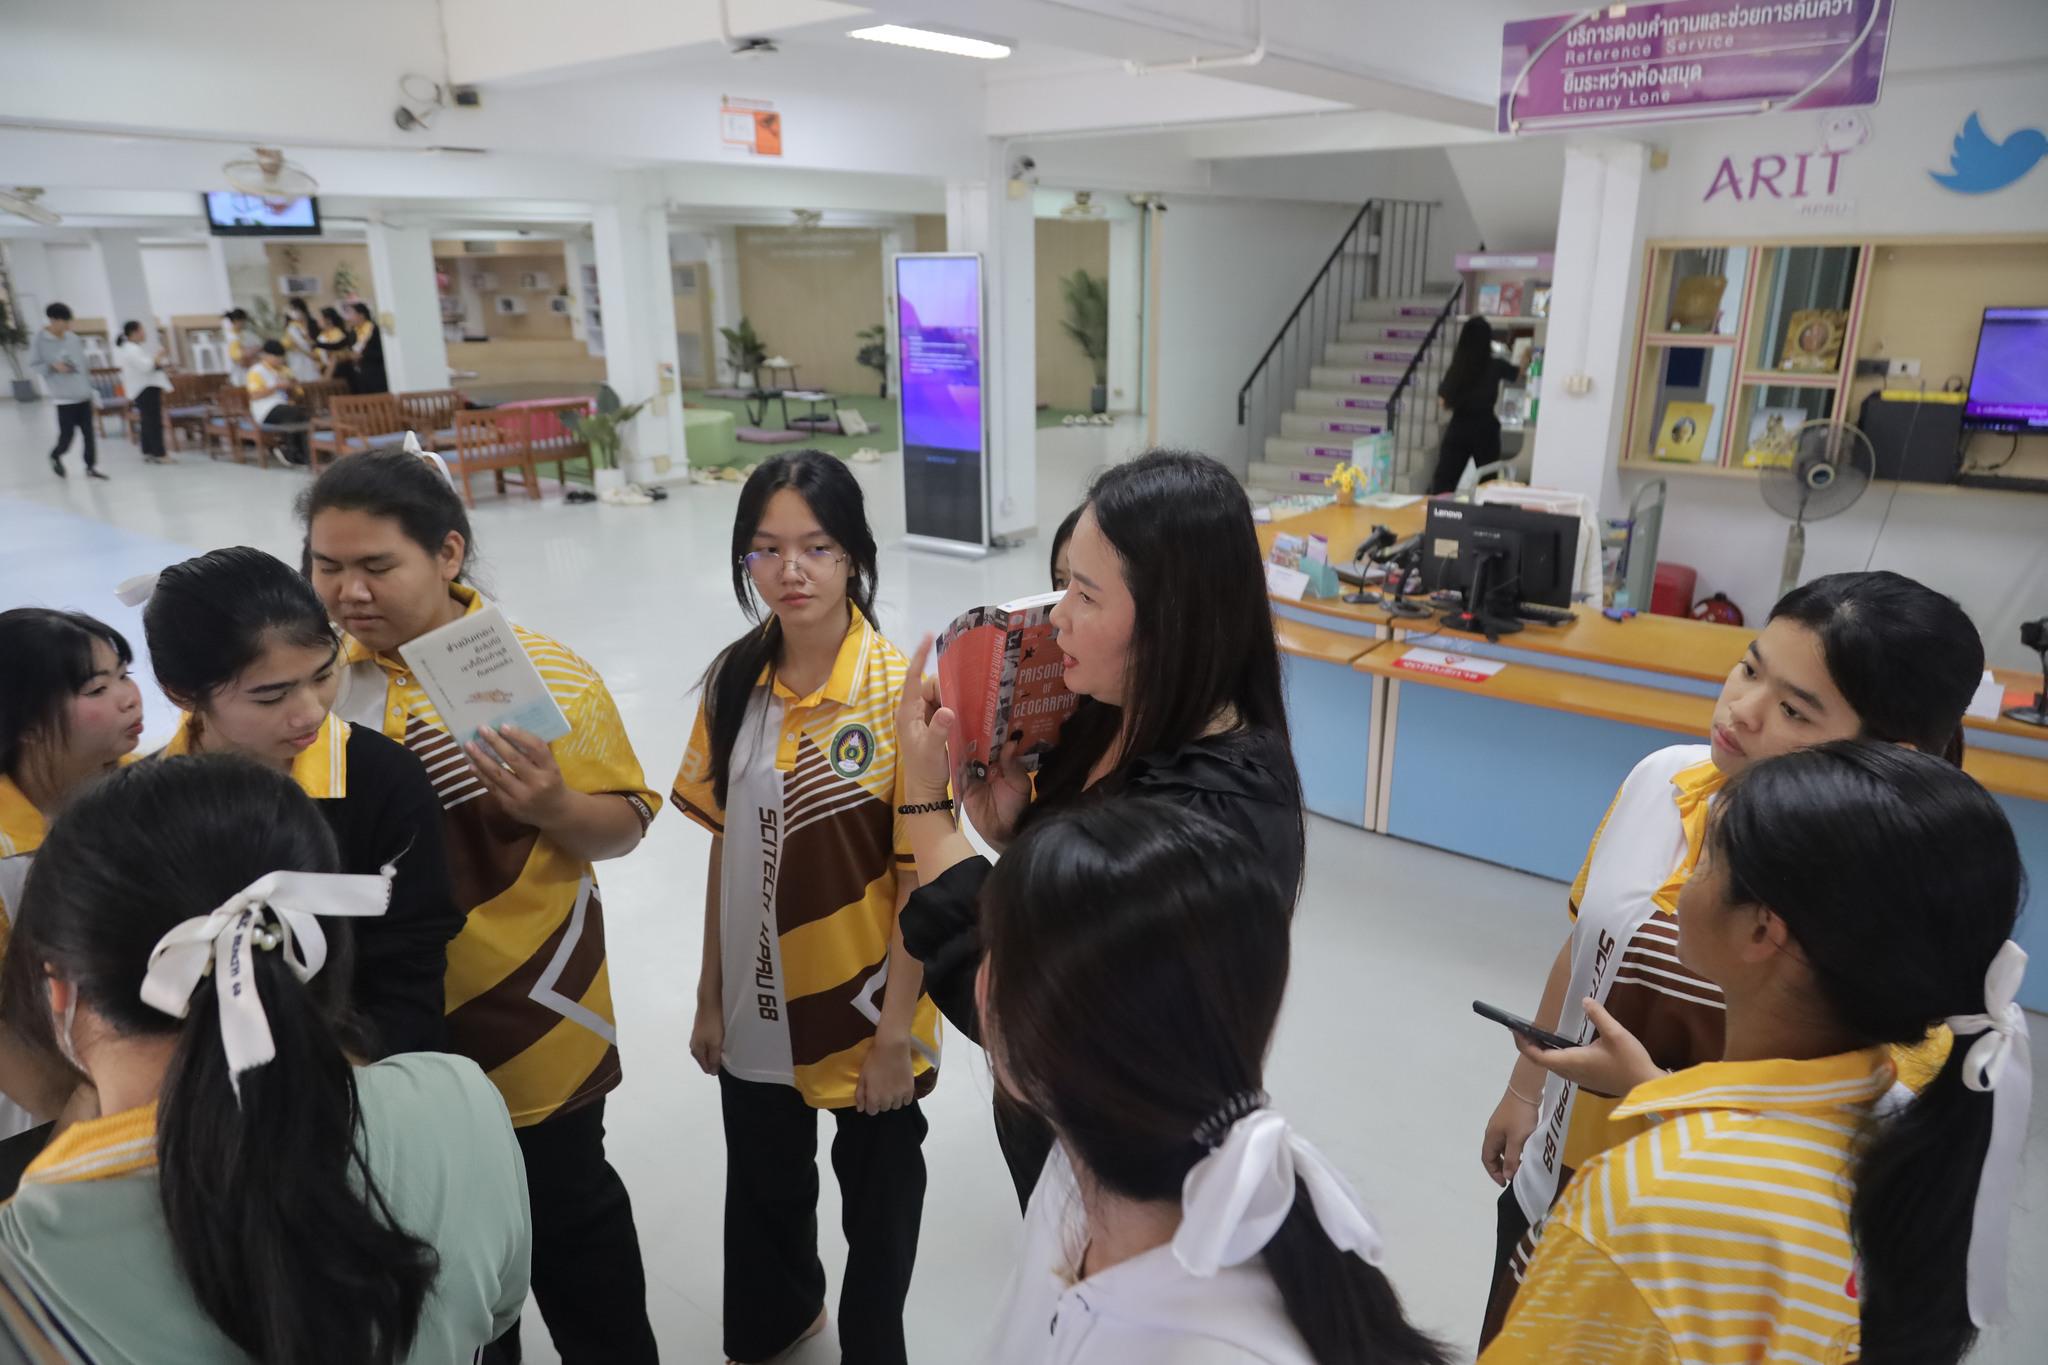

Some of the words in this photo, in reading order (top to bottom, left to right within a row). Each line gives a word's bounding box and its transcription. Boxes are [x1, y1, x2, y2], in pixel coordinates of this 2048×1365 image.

[1567, 0, 1852, 47] บริการตอบคำถามและช่วยการคนควา
[1565, 42, 1652, 65] Reference
[1666, 34, 1734, 54] Service
[1563, 94, 1621, 112] Library
[1629, 90, 1670, 106] Lone
[1702, 149, 1852, 202] ARIT
[1434, 507, 1463, 520] Lenovo
[1018, 660, 1064, 685] PRISONE
[1042, 682, 1052, 694] OF
[1013, 692, 1077, 719] GEOGRAPHY
[759, 806, 777, 914] SCITECH
[756, 921, 775, 990] KPRU
[759, 995, 779, 1022] 68
[1543, 1131, 1556, 1174] 68
